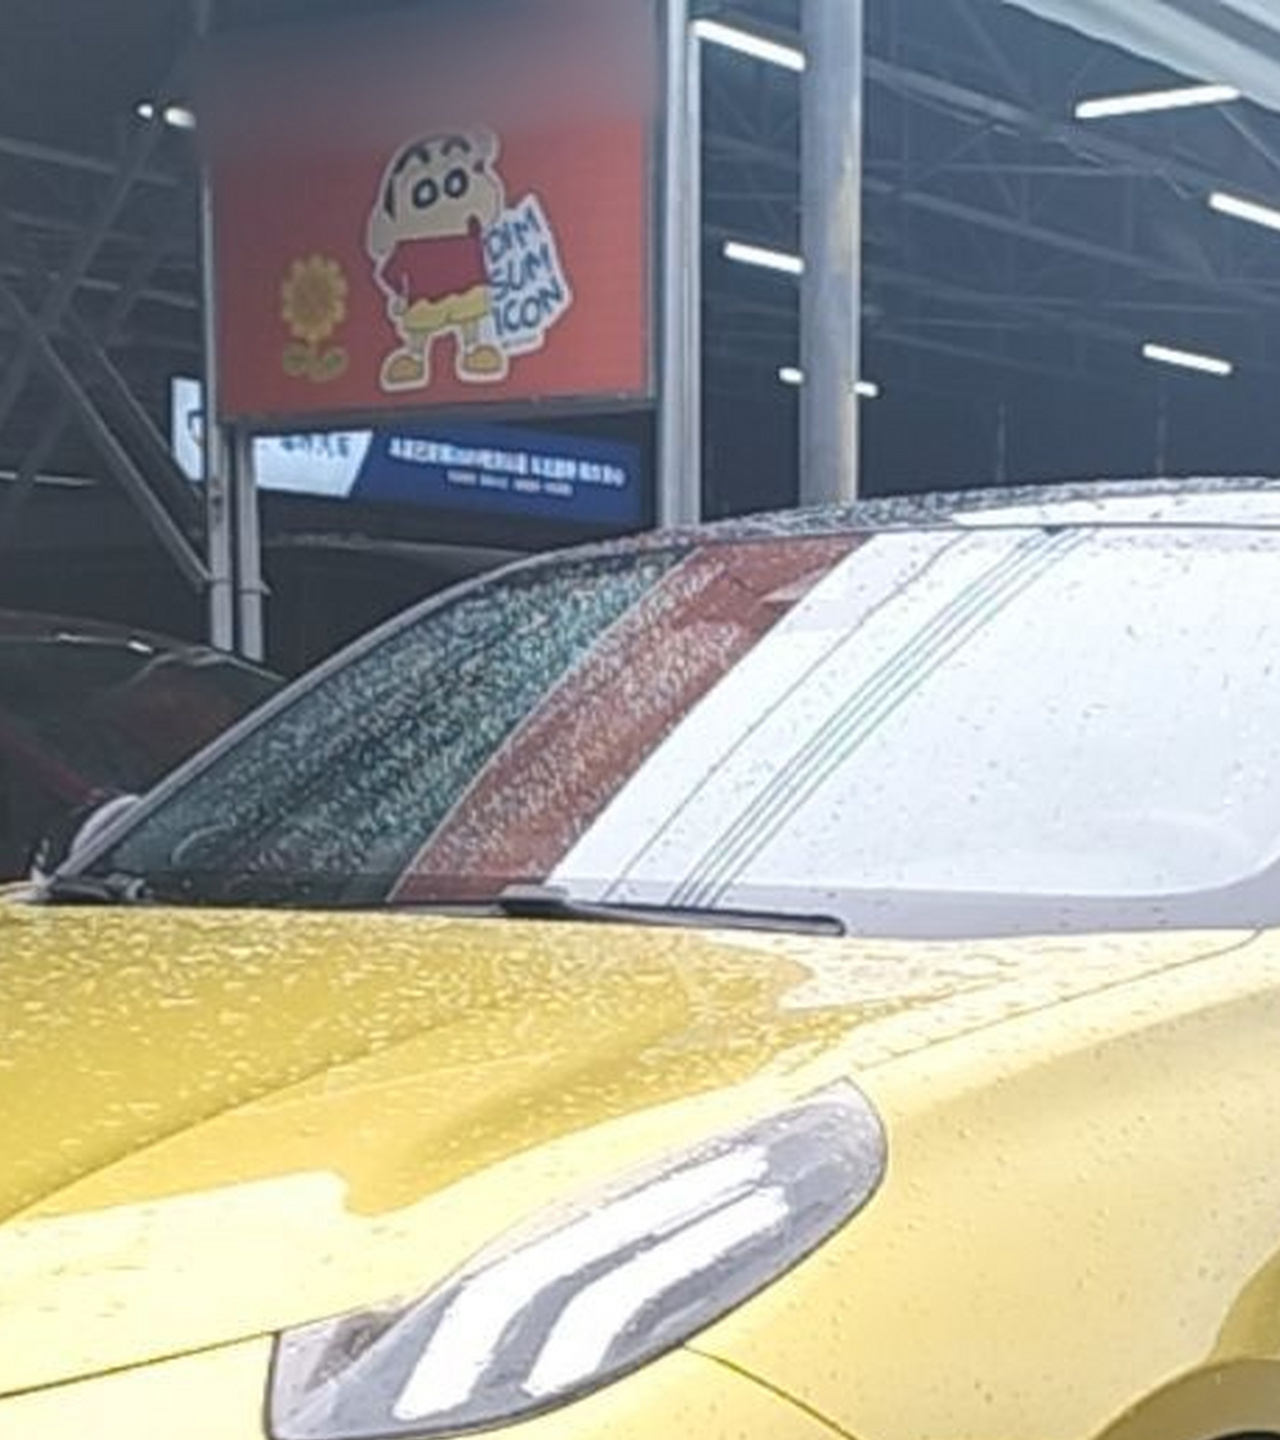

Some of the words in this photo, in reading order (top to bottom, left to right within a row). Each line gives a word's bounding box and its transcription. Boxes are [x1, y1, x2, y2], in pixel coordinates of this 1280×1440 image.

[487, 206, 542, 263] DIM
[490, 242, 552, 301] SUM
[491, 276, 562, 336] ICON
